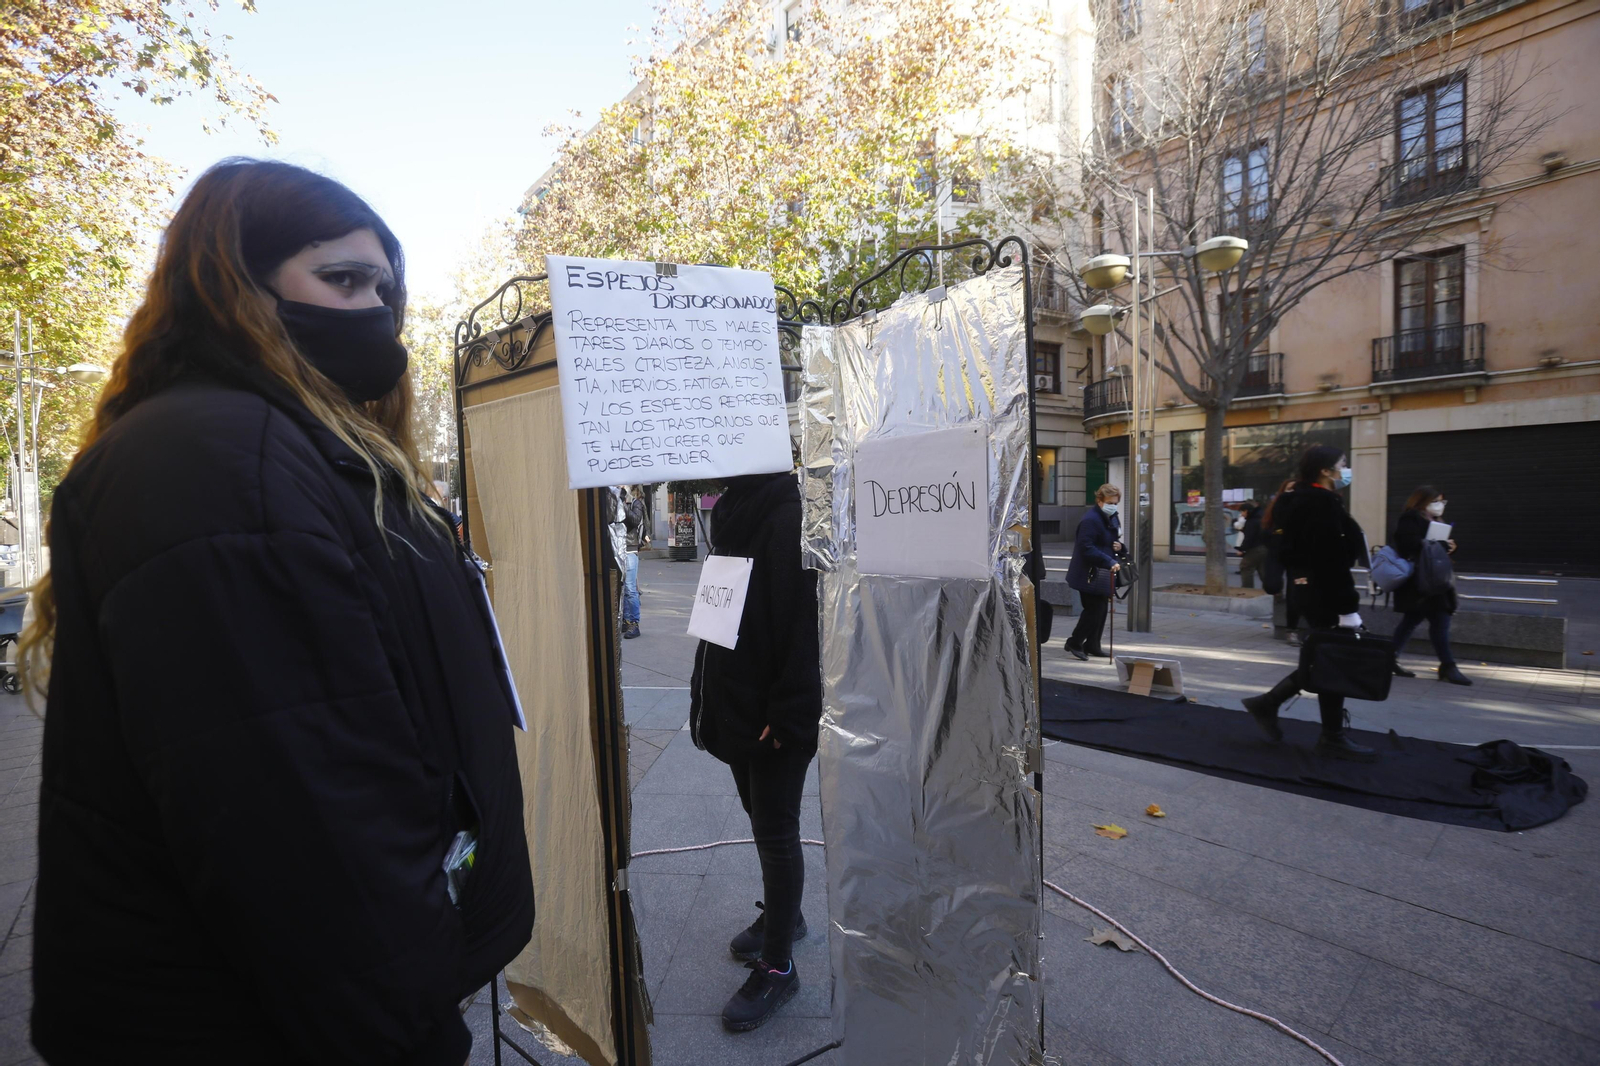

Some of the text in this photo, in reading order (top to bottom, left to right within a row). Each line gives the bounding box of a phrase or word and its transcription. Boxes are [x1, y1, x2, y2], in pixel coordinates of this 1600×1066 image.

[566, 265, 674, 291] ESPEJOS
[649, 292, 777, 313] DISTORSIONADOS
[568, 310, 776, 334] REPRESENTA TUS MALES-
[569, 334, 768, 352] TARES DIARIOS O TEMPO-
[574, 357, 625, 372] RALES
[579, 402, 588, 416] Y
[601, 401, 633, 416] LOS
[641, 397, 713, 414] ESPEJOS
[579, 415, 779, 435] TAN LOS TRASTORNOS QUE
[582, 433, 744, 454] TE HACEN CREER QUE
[587, 450, 715, 473] PUEDES TENER.
[863, 471, 976, 518] DEPRESIÓN
